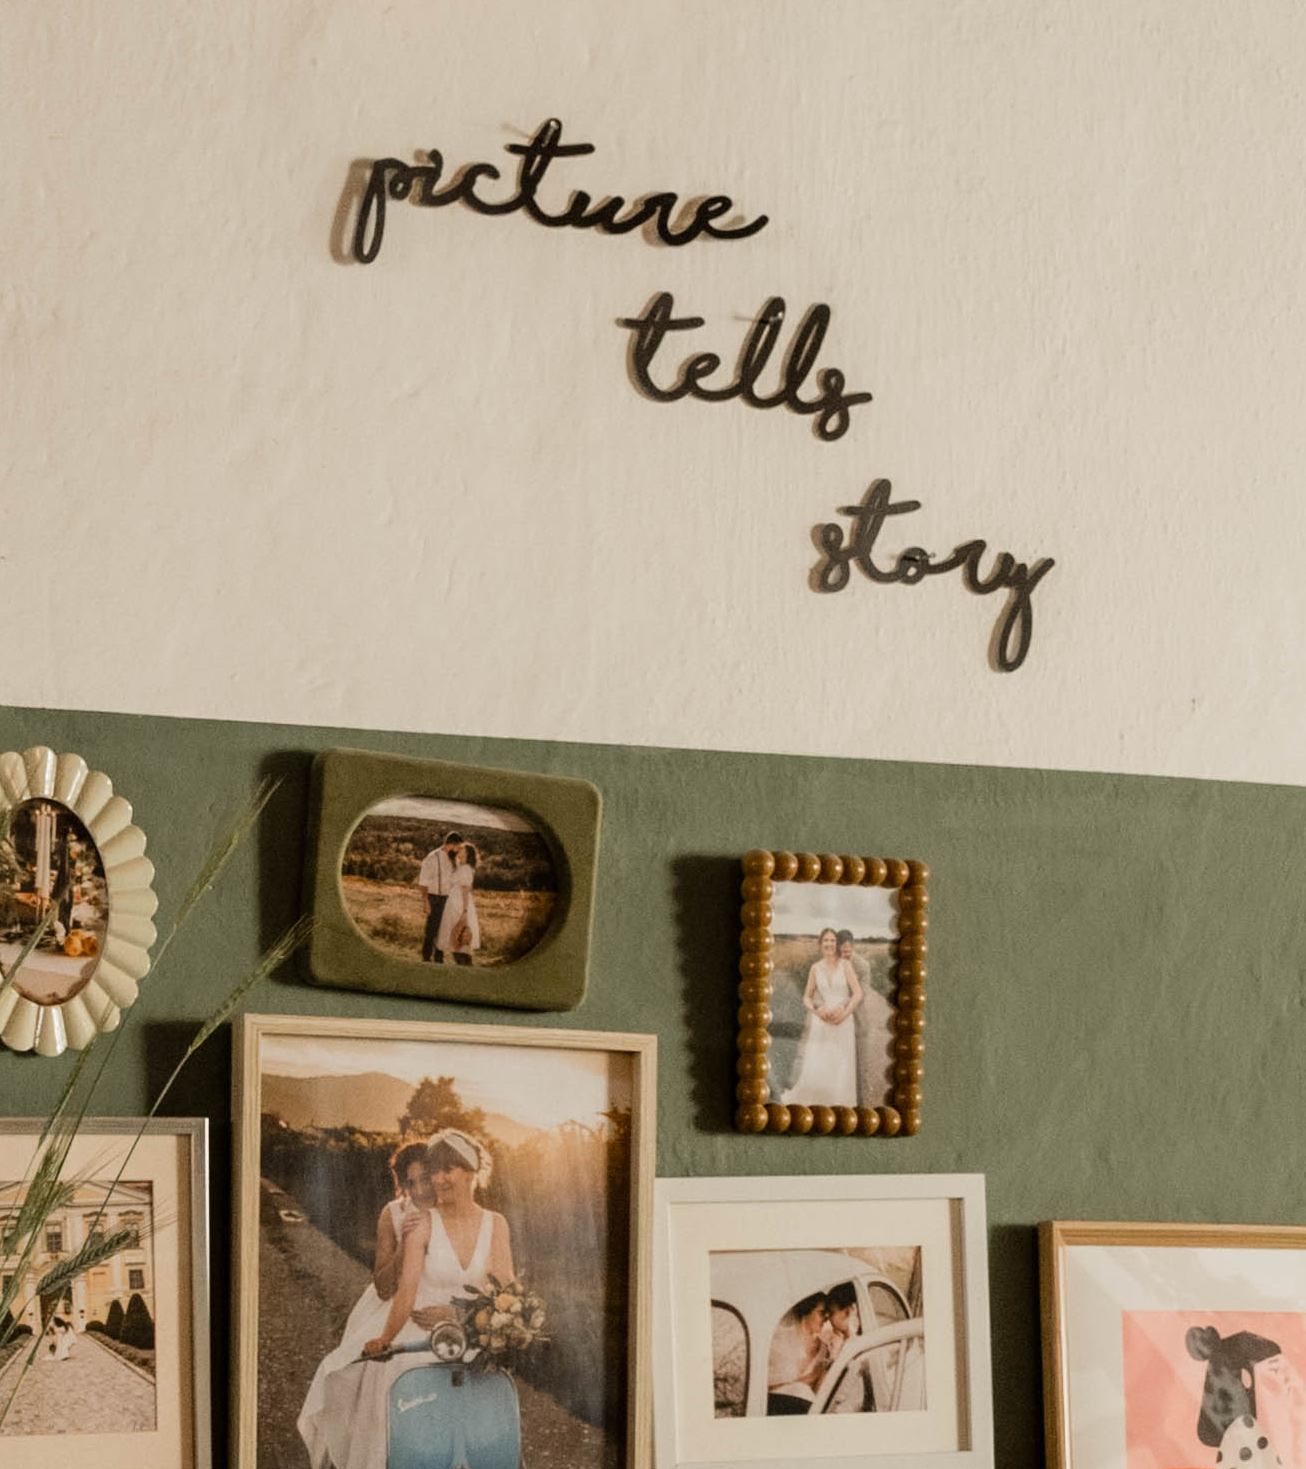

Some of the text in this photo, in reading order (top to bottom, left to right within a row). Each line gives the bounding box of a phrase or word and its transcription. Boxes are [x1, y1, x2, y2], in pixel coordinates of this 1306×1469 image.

[353, 119, 768, 263] picture
[619, 293, 872, 441] tells
[815, 480, 1054, 671] story
